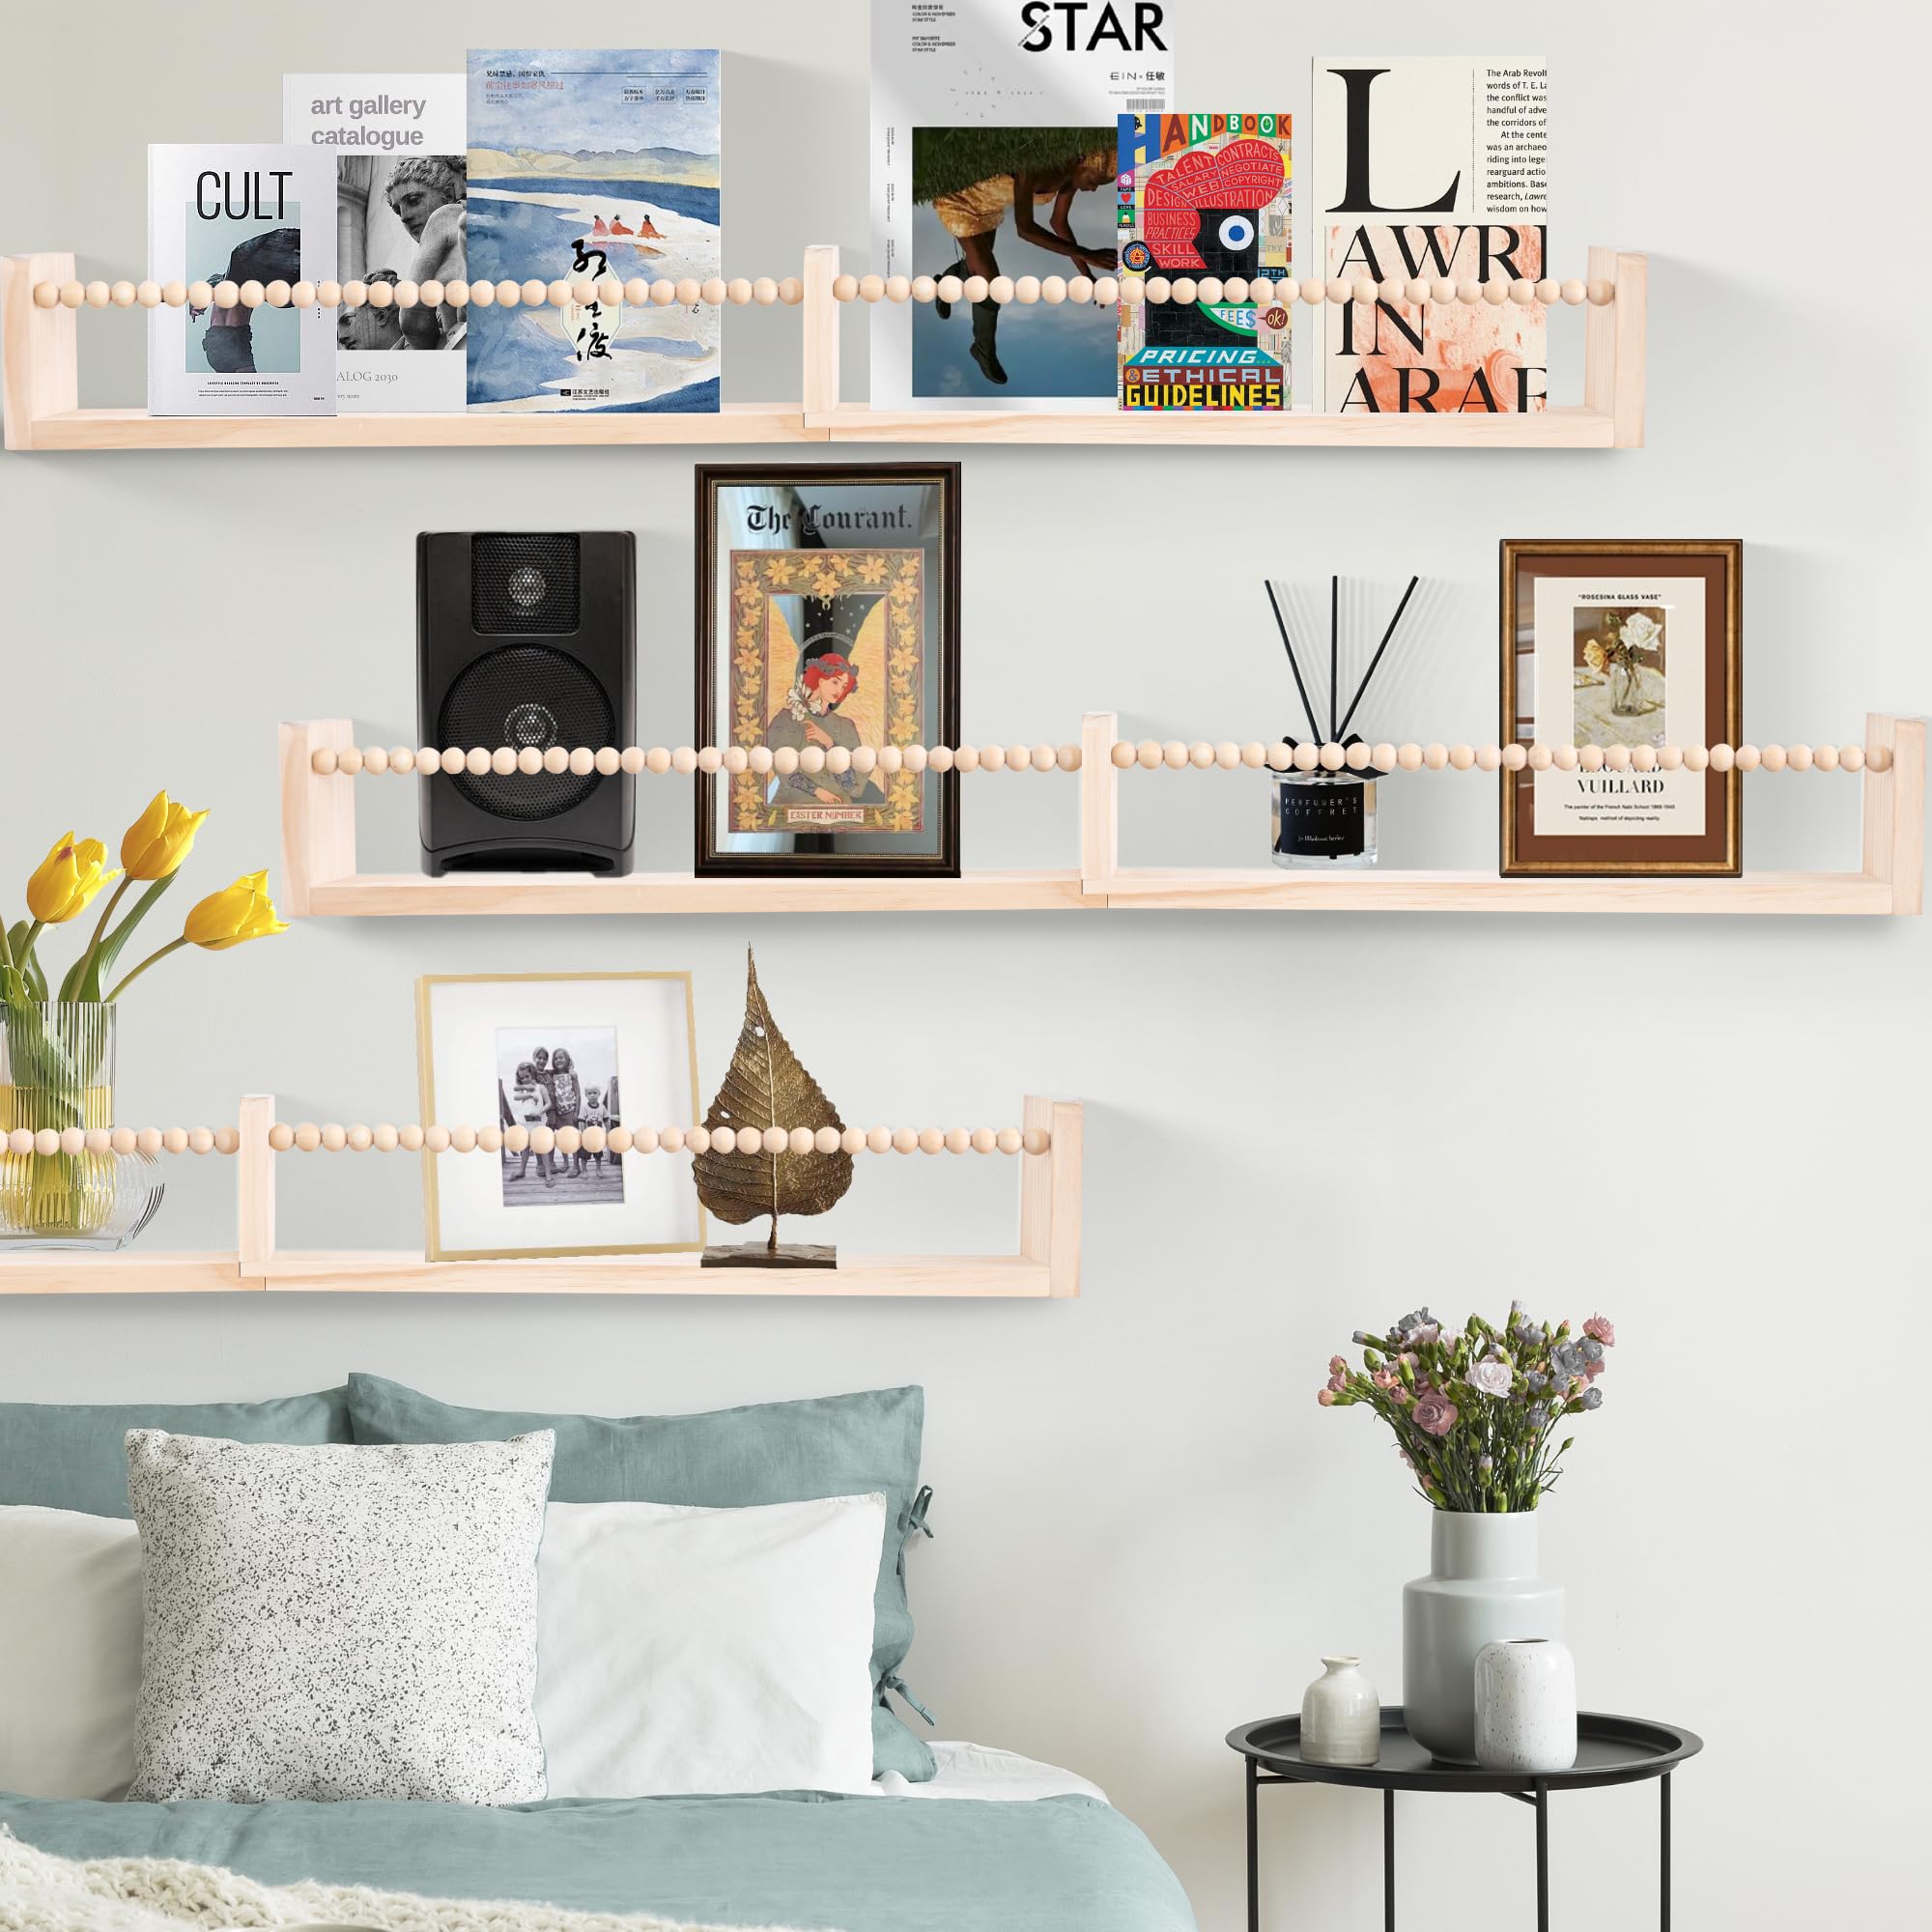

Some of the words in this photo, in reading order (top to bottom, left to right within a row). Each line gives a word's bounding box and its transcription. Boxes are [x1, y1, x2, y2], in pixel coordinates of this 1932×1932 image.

[1021, 1, 1168, 52] STAR
[1487, 69, 1501, 77] The
[1503, 69, 1521, 77] Arab
[311, 96, 342, 116] art
[349, 95, 427, 120] gallery
[311, 126, 424, 150] catalogue
[1118, 114, 1292, 175] HANDBOOK
[1325, 69, 1462, 213] L
[1218, 142, 1279, 167] CONTRACTS
[1487, 156, 1510, 164] riding
[1529, 156, 1546, 164] lege
[1156, 155, 1212, 186] TALENT
[1222, 161, 1283, 178] NEGOTIATE
[1487, 168, 1525, 177] rearguard
[1172, 170, 1217, 192] SALARY
[1183, 181, 1219, 199] WEB
[1224, 175, 1283, 188] COPYRIGHT
[196, 170, 293, 221] CULT
[1148, 188, 1187, 208] DESIGN
[1195, 190, 1273, 208] ILLUSTRATION
[1148, 213, 1196, 226] BUSINESS
[1146, 227, 1197, 241] PRACTICES
[1152, 243, 1195, 255] SKILL
[1337, 224, 1547, 284] AWR
[1158, 258, 1200, 268] WORK
[375, 374, 398, 384] 2030
[1143, 369, 1281, 384] ETHICAL
[1126, 384, 1280, 406] GUIDELINES
[747, 504, 792, 534] The
[803, 504, 912, 535] Courant.
[1577, 780, 1664, 793] VUILLARD
[1286, 807, 1357, 815] COFFRET
